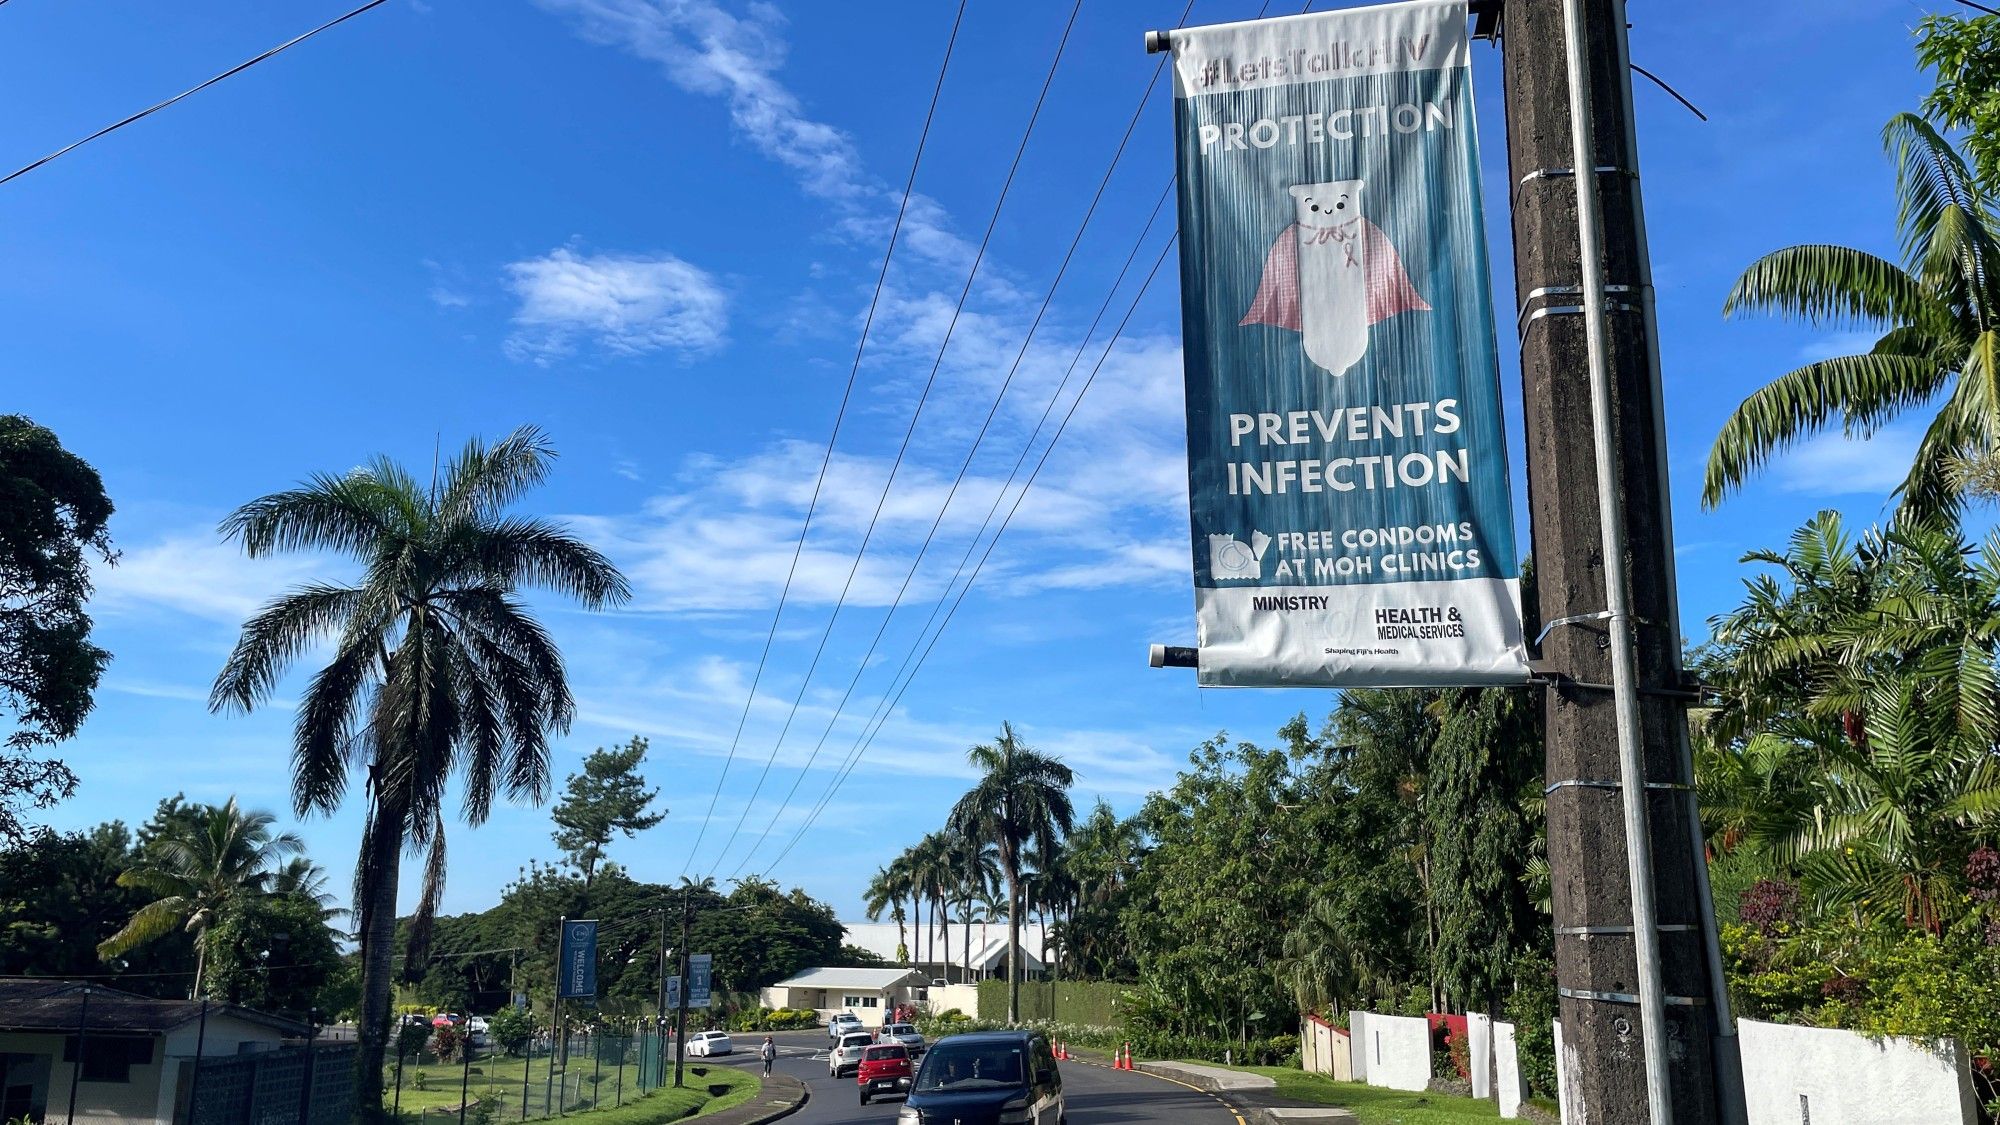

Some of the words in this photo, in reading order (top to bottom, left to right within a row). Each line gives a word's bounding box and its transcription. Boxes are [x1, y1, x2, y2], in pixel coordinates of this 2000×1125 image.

[1199, 101, 1454, 155] PROTECTION
[1229, 398, 1461, 447] PREVENTS
[1227, 448, 1470, 496] INFECTION
[1278, 530, 1333, 551] FREE
[1341, 522, 1473, 548] CONDOMS
[1275, 558, 1305, 577] AT
[1314, 551, 1373, 577] MOH
[1380, 549, 1481, 574] CLINICS
[1252, 596, 1329, 611] MINISTRY
[1375, 607, 1442, 624] HEALTH
[1447, 606, 1462, 622] &
[1377, 625, 1418, 640] MEDICAL
[1419, 623, 1465, 639] SERVICES
[1324, 647, 1355, 655] Shaping
[1374, 647, 1399, 655] Health
[576, 950, 584, 993] WELCOME
